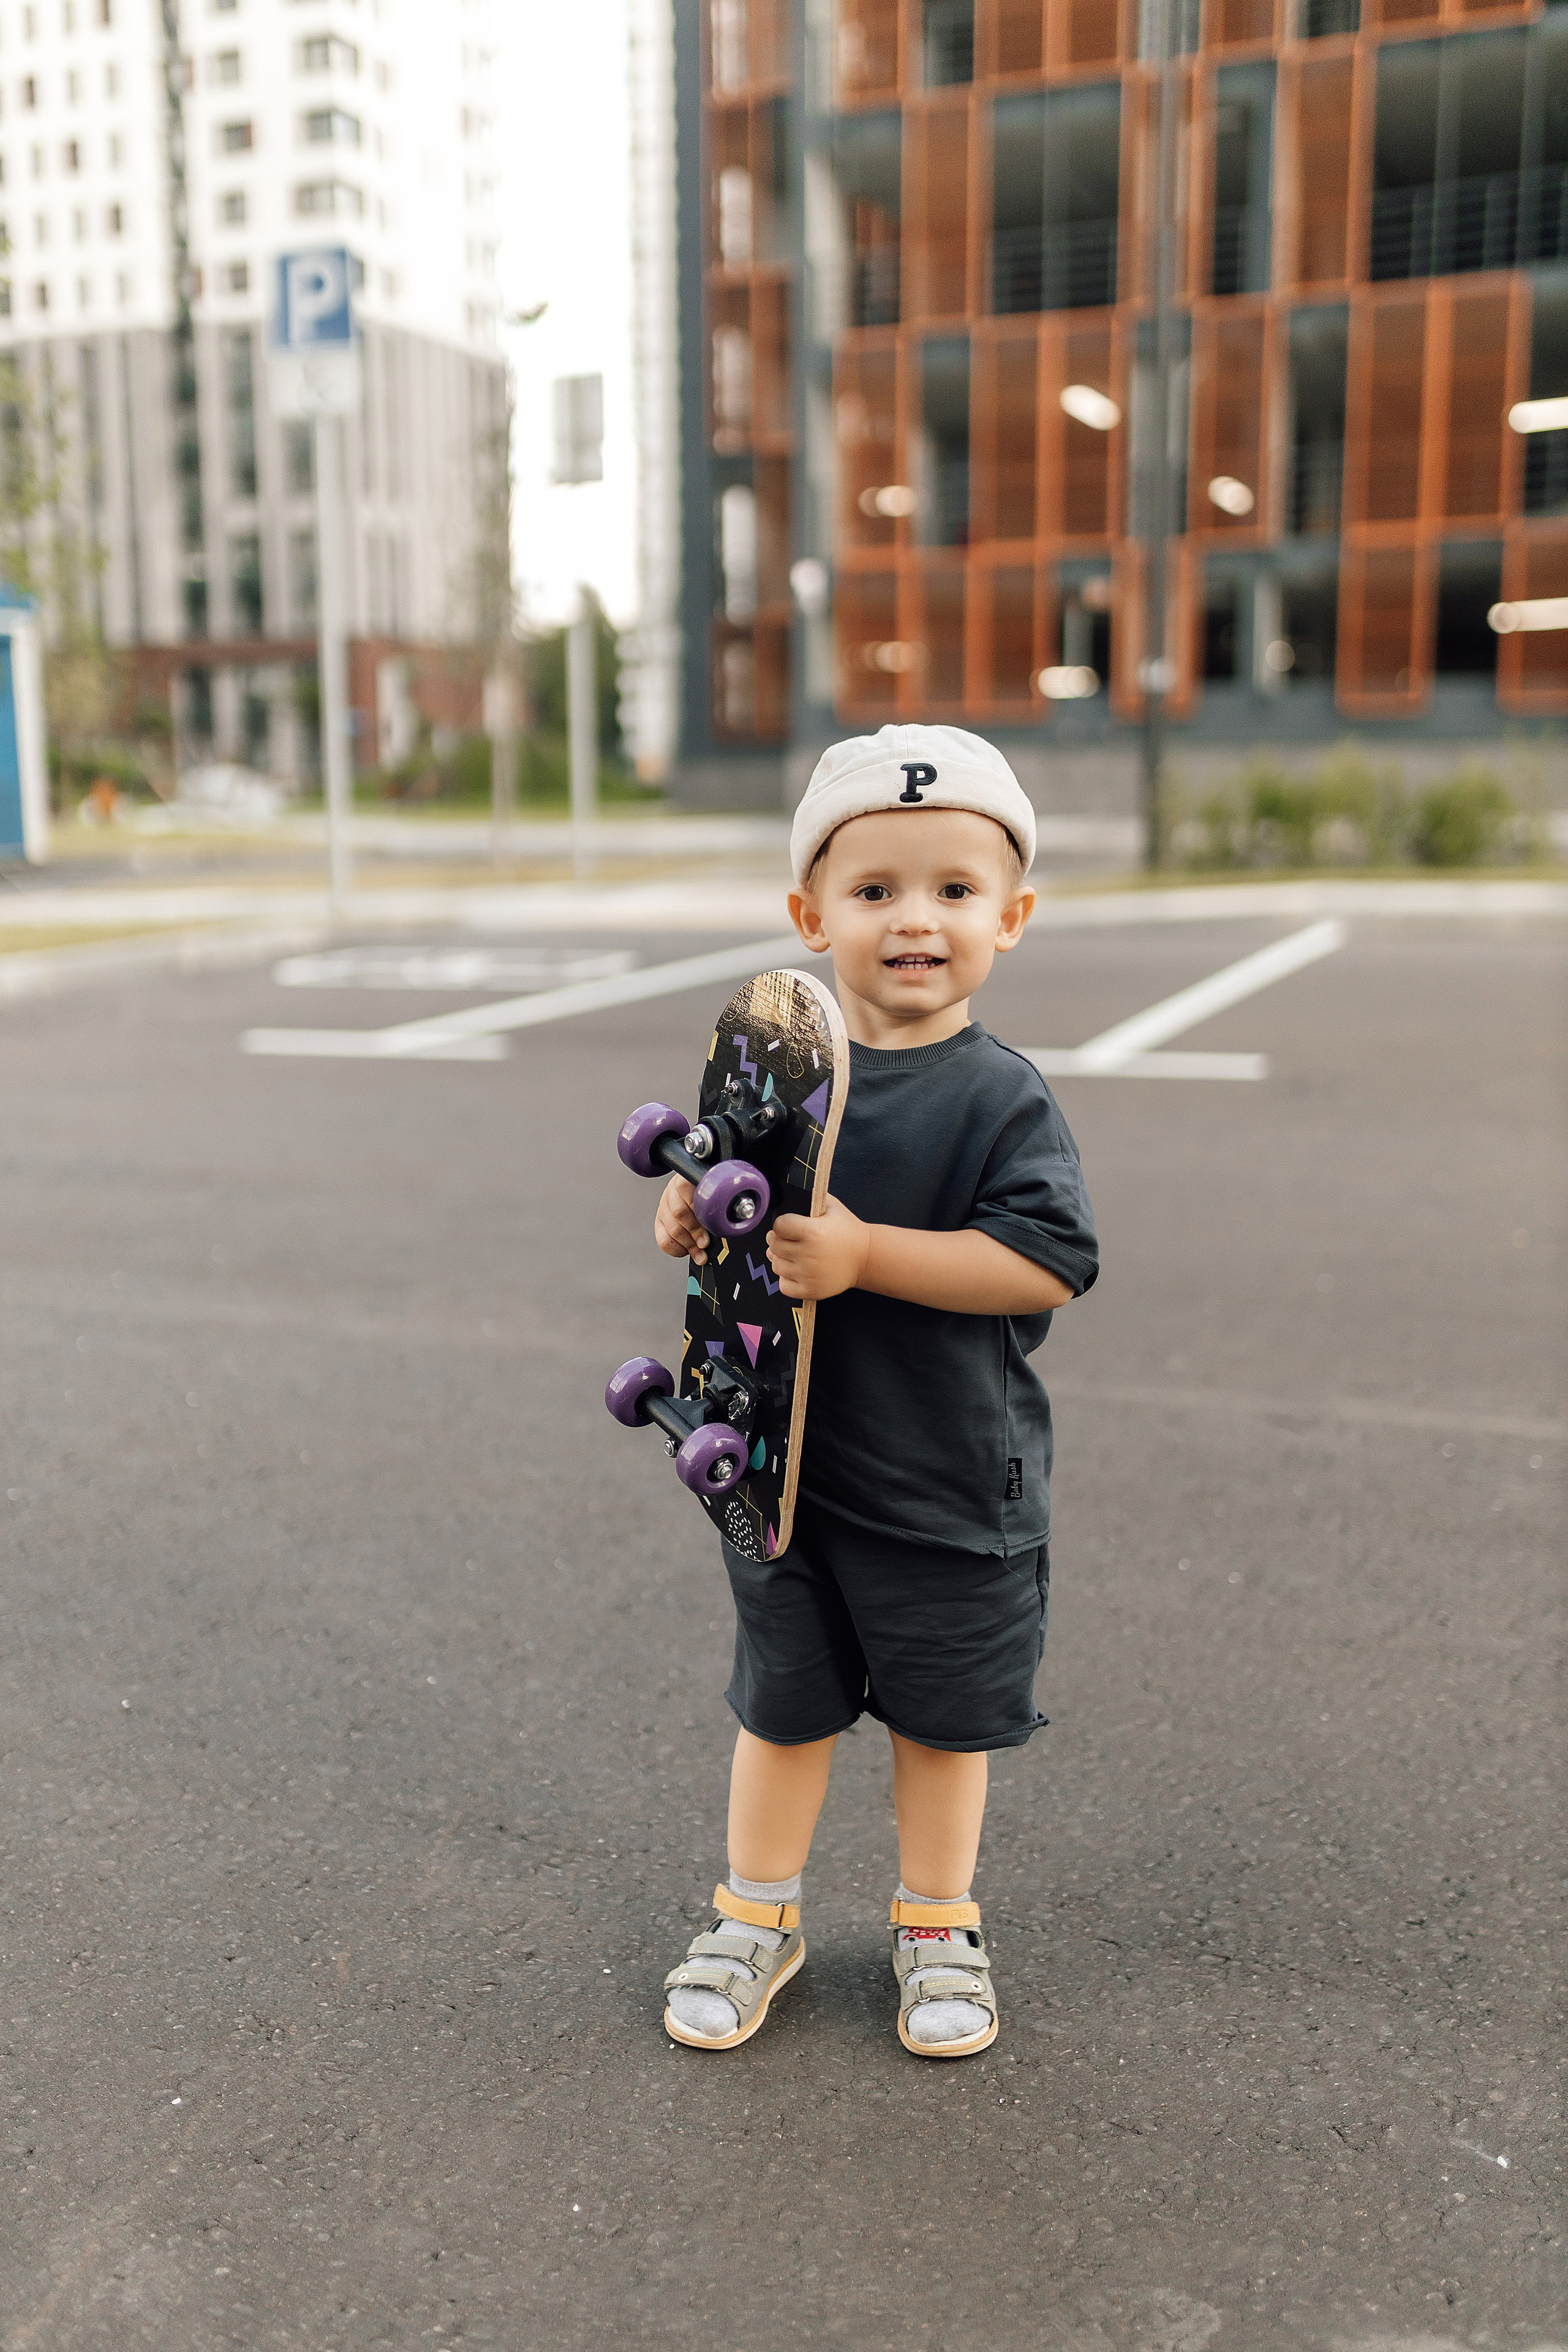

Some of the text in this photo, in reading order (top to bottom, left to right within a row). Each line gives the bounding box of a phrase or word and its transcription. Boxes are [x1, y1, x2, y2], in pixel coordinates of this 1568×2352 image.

[288, 254, 343, 341] P
[899, 763, 938, 803] P
[1010, 1480, 1022, 1498] Baby
